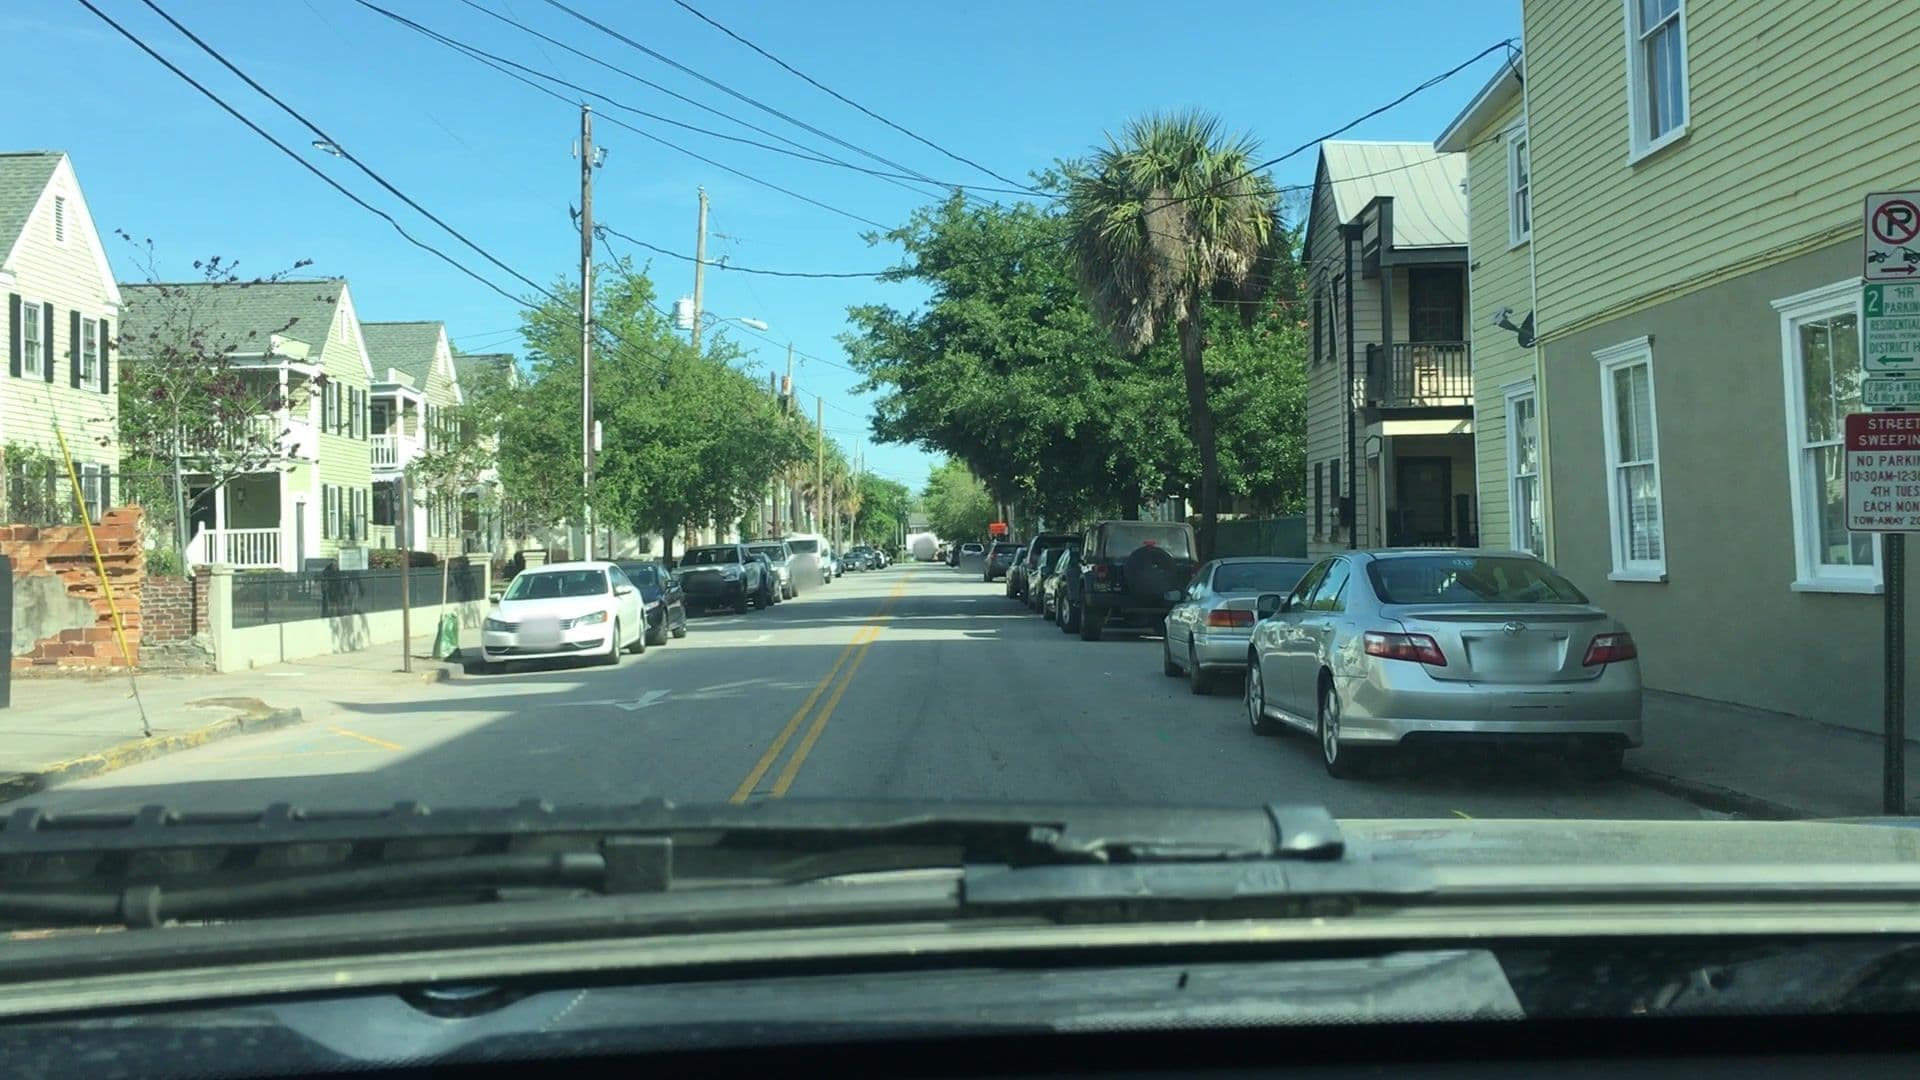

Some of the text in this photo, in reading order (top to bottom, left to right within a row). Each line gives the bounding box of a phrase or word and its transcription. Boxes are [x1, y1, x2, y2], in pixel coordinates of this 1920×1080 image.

[1868, 290, 1879, 312] 2
[1869, 341, 1909, 353] DISTRICT
[1868, 418, 1920, 430] STREET
[1857, 455, 1873, 467] NO
[1871, 485, 1920, 497] 4TH TUES
[1864, 501, 1891, 512] EACH
[1854, 516, 1904, 525] TOW-AWAY
